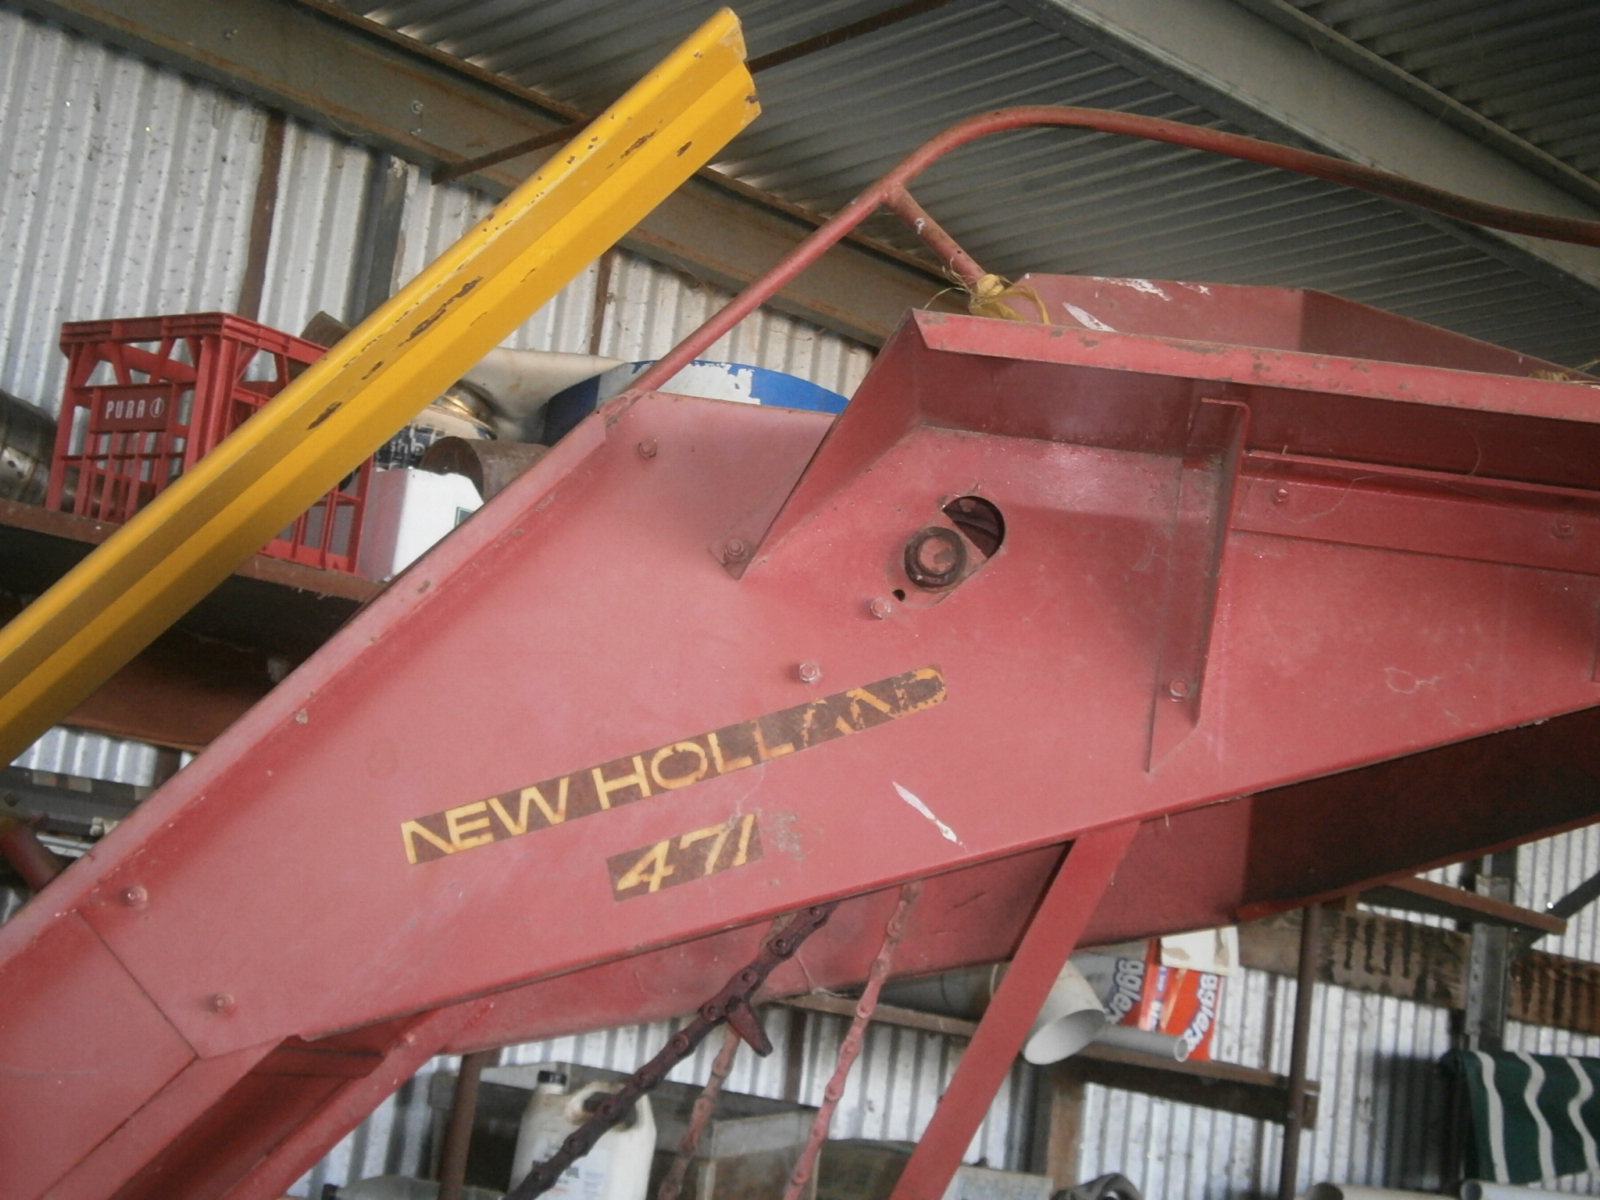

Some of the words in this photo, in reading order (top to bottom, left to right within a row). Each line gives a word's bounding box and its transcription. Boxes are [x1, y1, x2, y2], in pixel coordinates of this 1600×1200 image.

[105, 399, 146, 419] PURA
[400, 777, 570, 865] NEW
[591, 667, 948, 810] HOLLAND
[616, 813, 755, 894] 471
